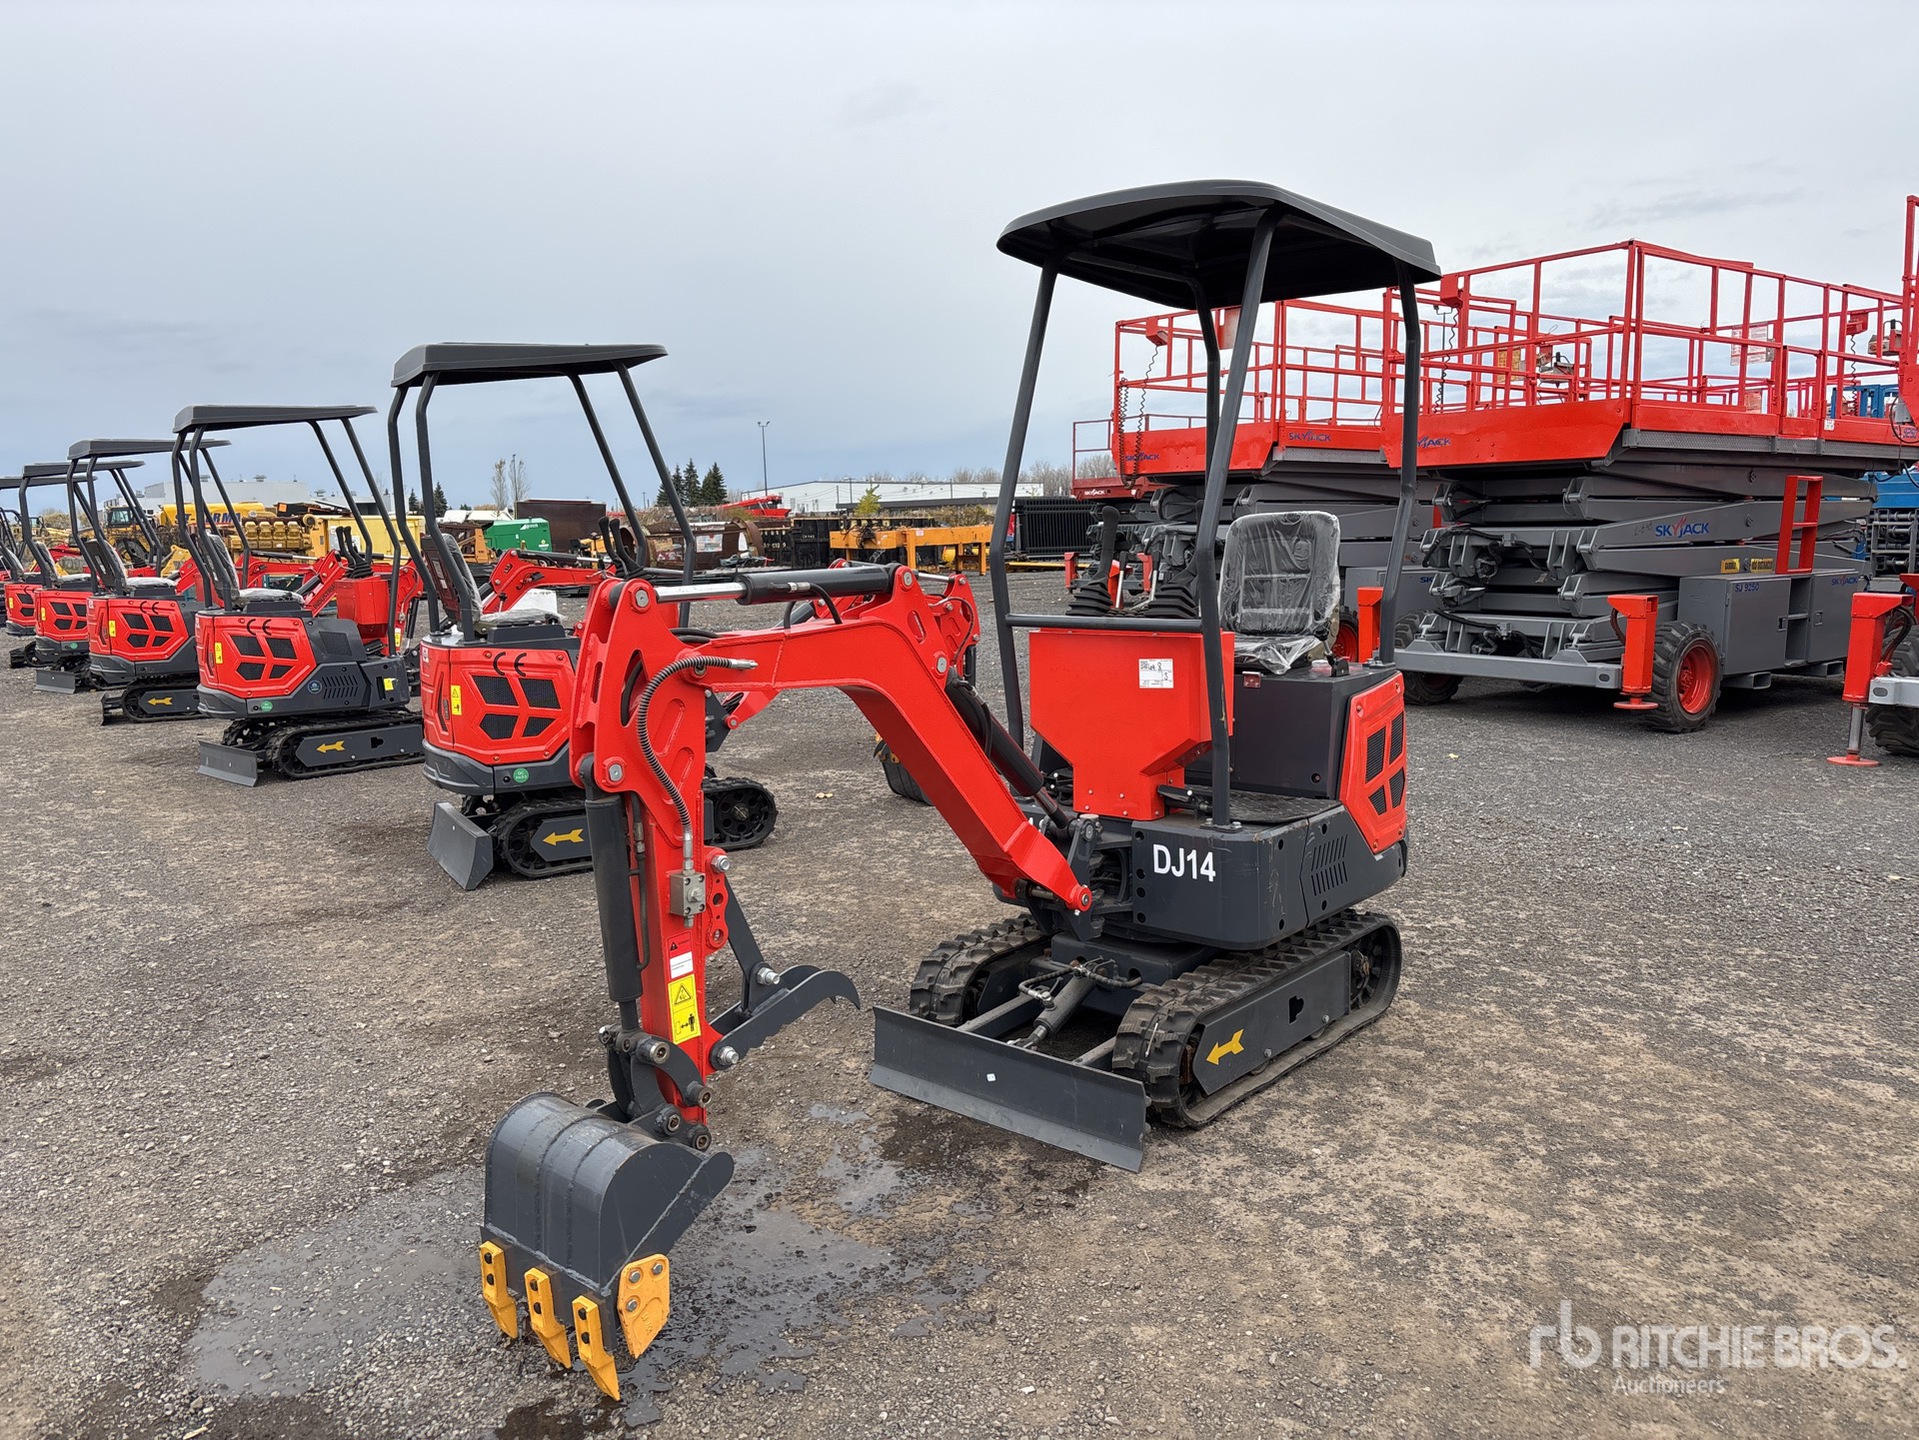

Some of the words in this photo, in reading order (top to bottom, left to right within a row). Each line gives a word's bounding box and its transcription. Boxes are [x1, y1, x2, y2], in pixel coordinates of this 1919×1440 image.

[1655, 516, 1710, 538] SKYJACK
[1735, 583, 1743, 592] SJ
[1745, 582, 1760, 592] 9250
[493, 651, 527, 677] CE
[1153, 844, 1216, 882] DJ14
